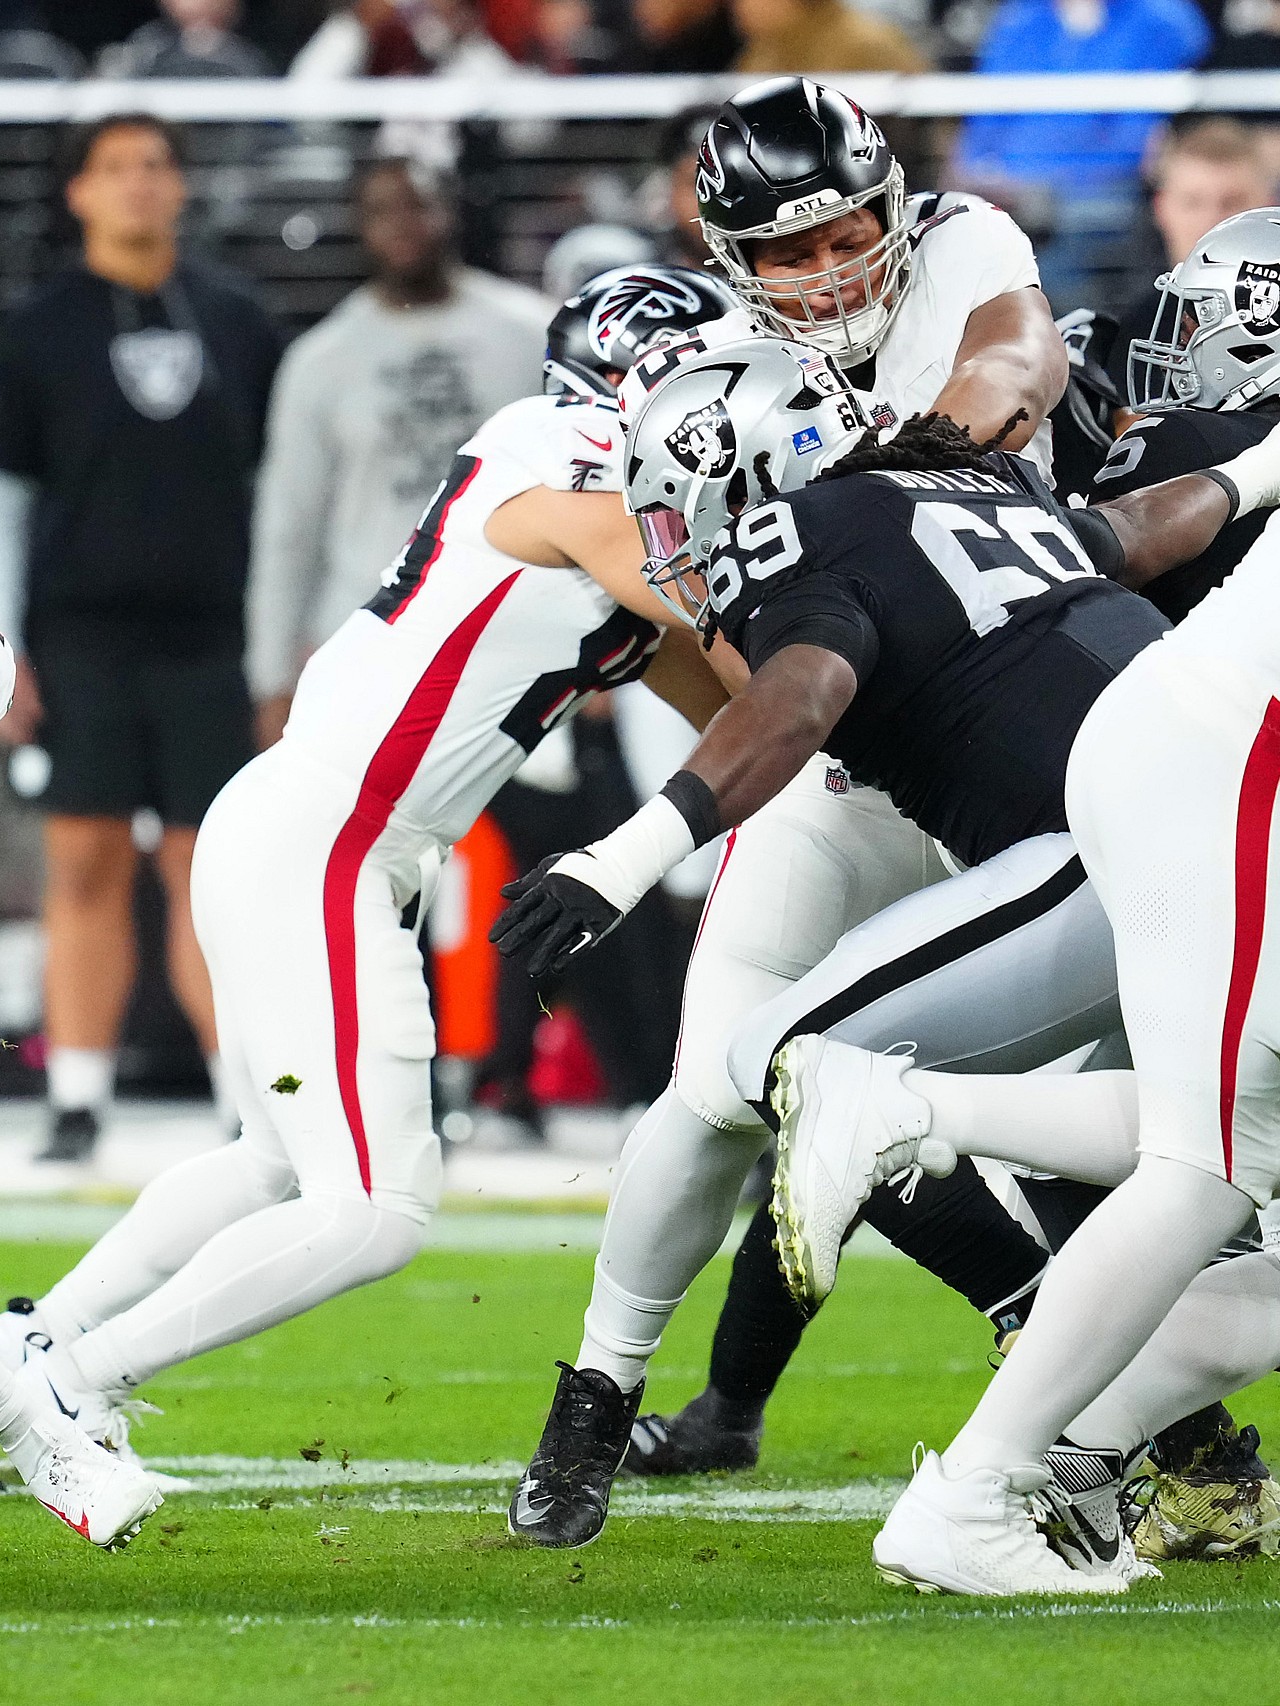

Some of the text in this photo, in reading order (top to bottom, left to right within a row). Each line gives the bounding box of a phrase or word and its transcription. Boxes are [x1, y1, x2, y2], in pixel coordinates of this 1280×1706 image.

[793, 197, 827, 215] ATL
[1245, 263, 1280, 282] RAID
[706, 500, 803, 615] 69
